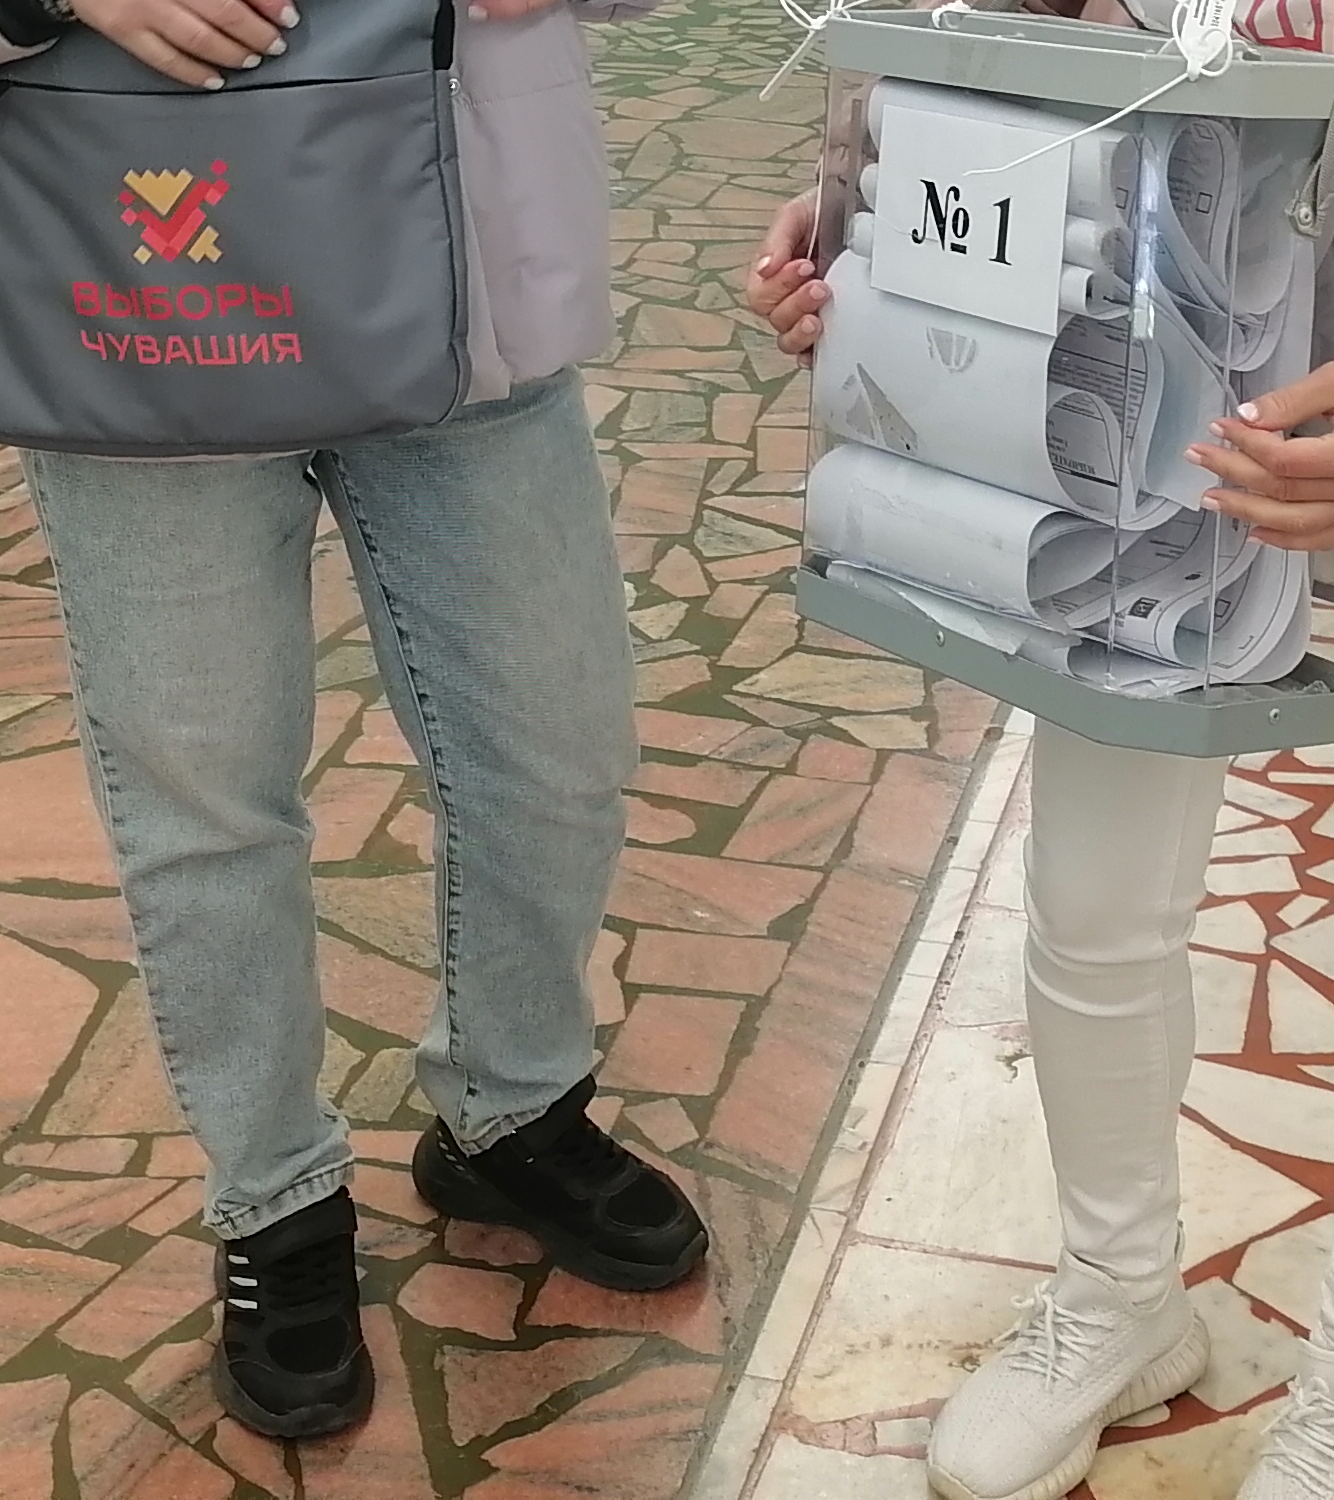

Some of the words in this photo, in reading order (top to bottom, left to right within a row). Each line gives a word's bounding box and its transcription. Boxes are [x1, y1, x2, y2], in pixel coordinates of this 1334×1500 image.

[911, 178, 971, 256] №
[988, 195, 1014, 267] 1
[71, 280, 295, 321] ВЫБОРЫ
[80, 329, 304, 366] ЧУВАШИЯ
